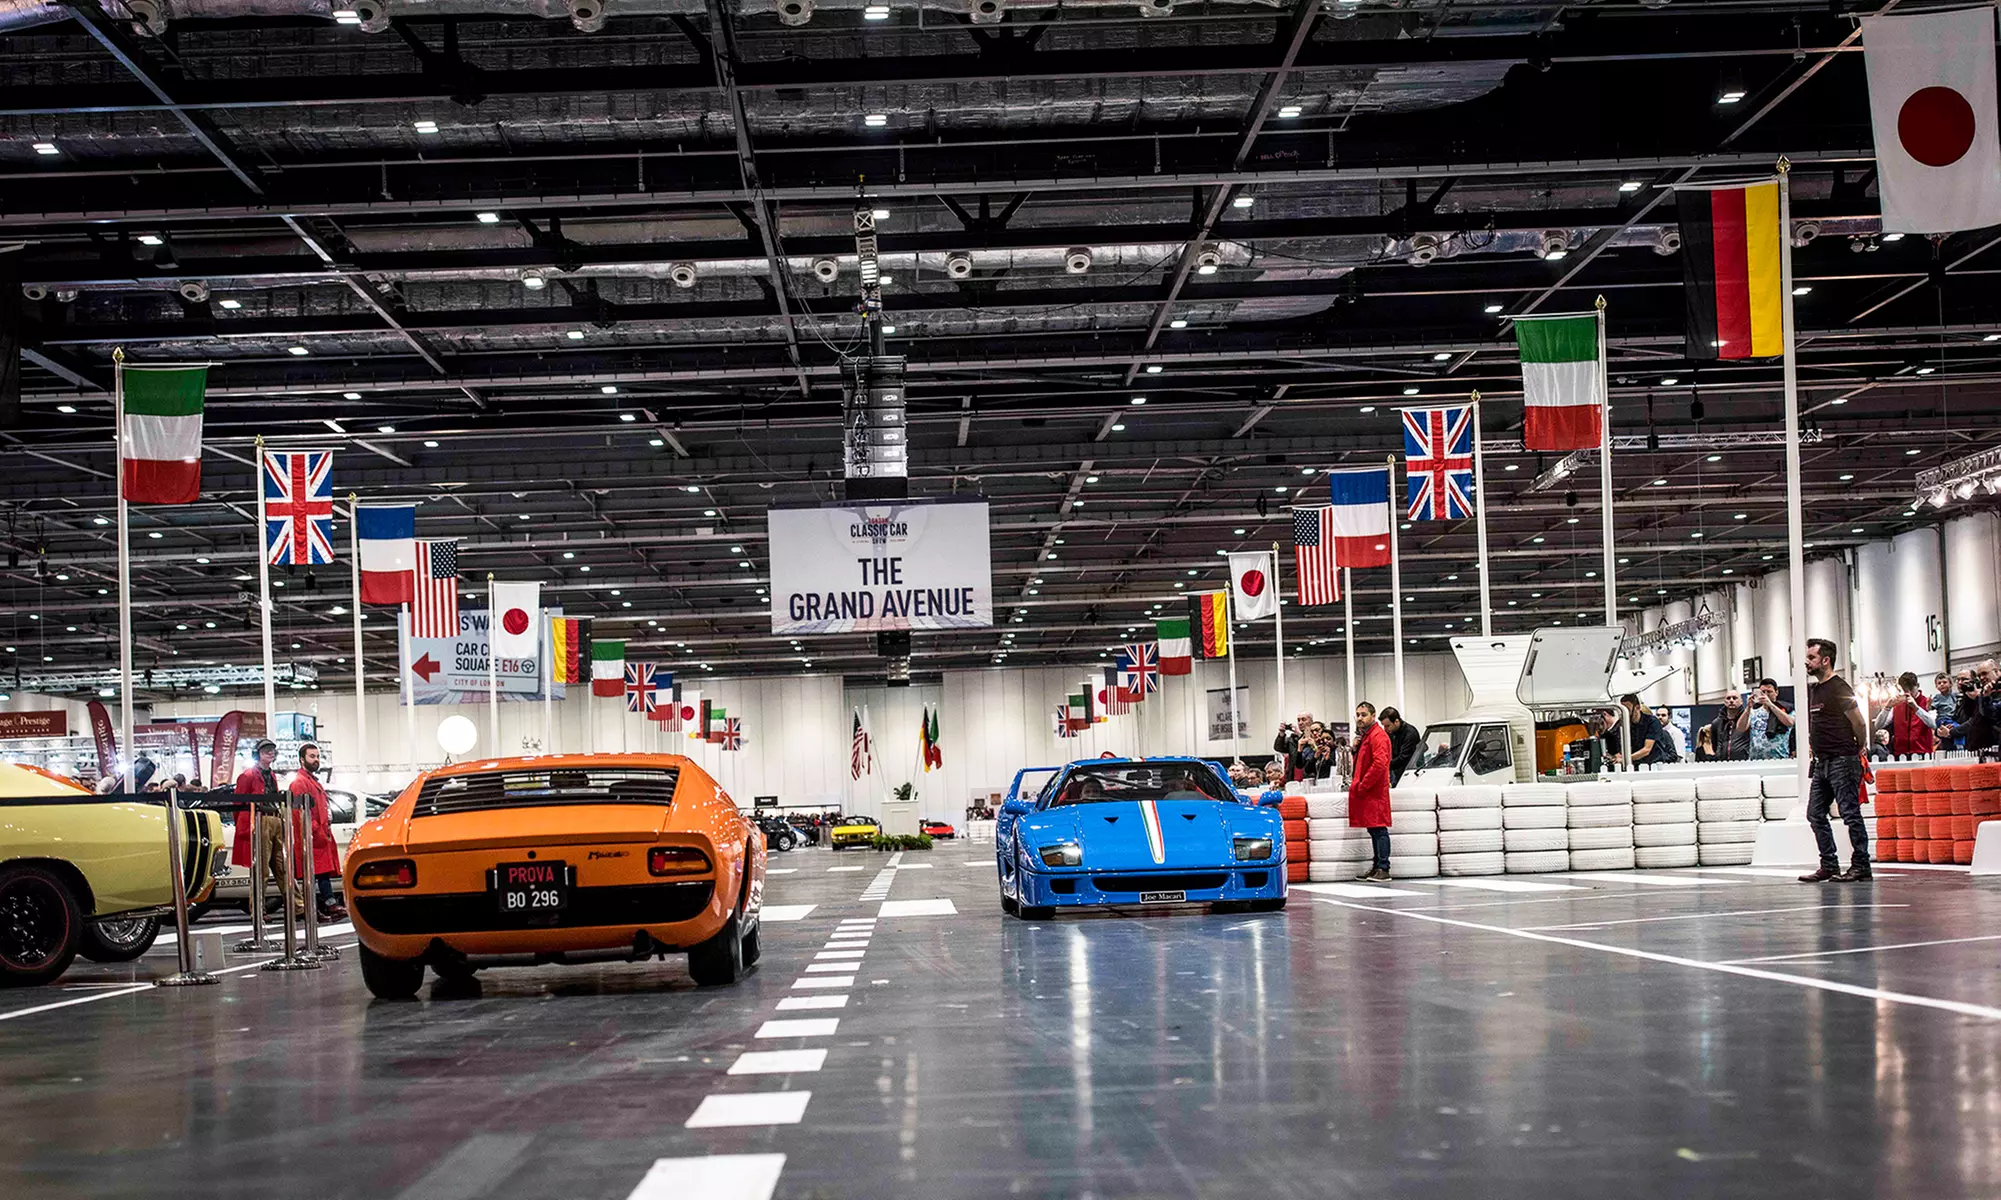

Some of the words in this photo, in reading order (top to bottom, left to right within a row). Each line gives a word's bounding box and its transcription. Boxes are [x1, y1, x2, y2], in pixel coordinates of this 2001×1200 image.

[850, 524, 888, 538] CLASSIC
[889, 523, 908, 537] CAR
[857, 557, 903, 586] THE
[789, 591, 874, 621] GRAND
[881, 587, 975, 618] AVENUE
[1925, 614, 1938, 652] 15
[455, 642, 478, 656] CAR
[502, 660, 519, 672] E16
[20, 716, 51, 726] Prestige
[217, 729, 233, 775] Prestige
[508, 866, 554, 884] PROVA
[507, 892, 526, 908] BO
[531, 890, 559, 907] 296
[1143, 893, 1157, 901] Joe
